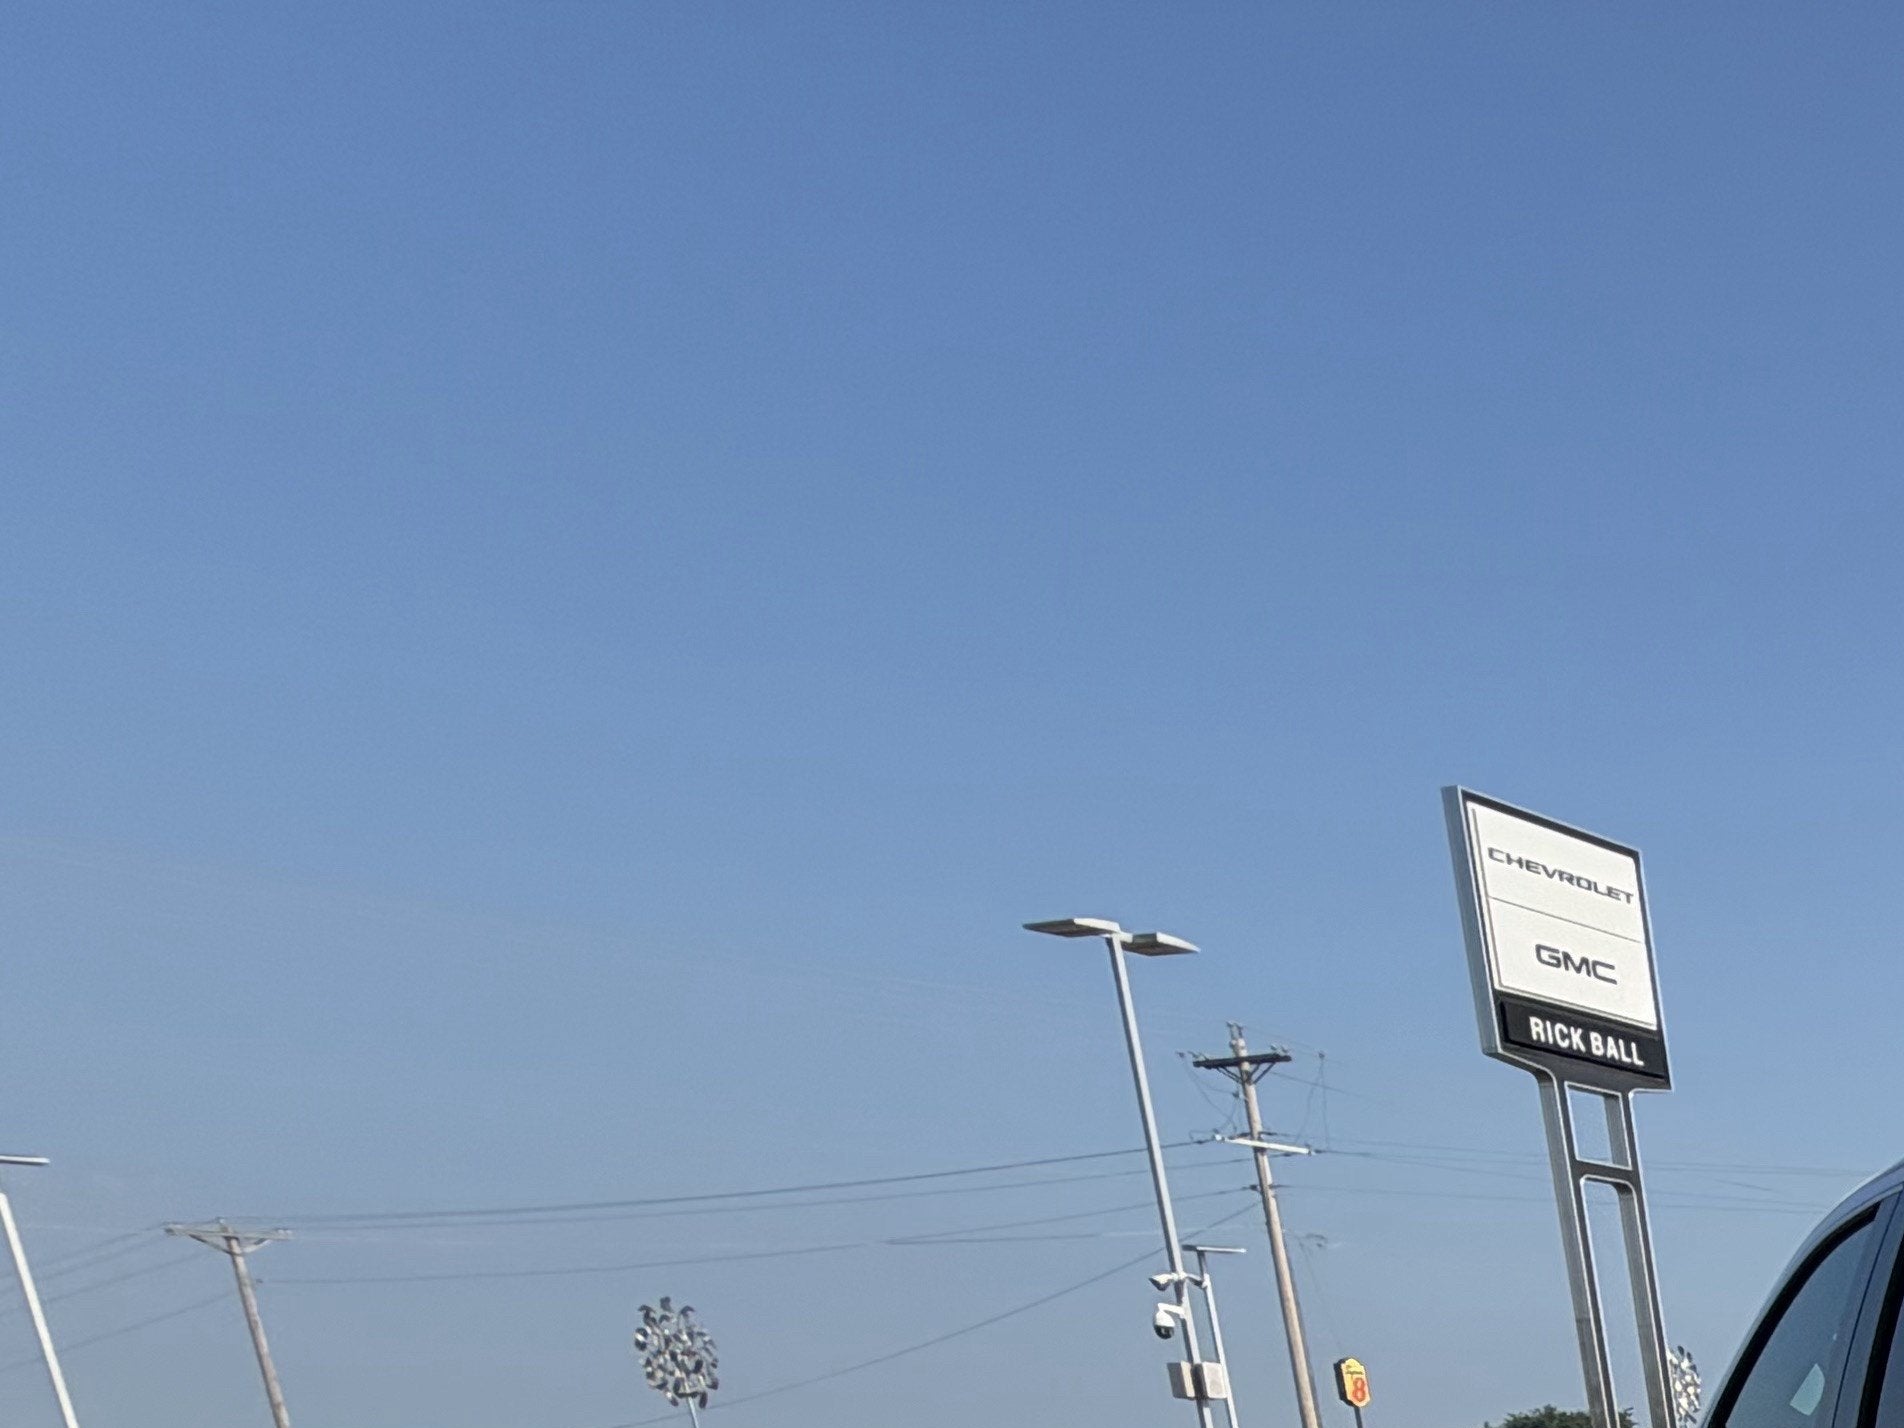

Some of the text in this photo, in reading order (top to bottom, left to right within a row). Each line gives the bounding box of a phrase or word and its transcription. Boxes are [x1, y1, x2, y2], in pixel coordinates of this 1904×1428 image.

[1487, 846, 1634, 904] CHEVROLET
[1535, 943, 1617, 985] GMC
[1528, 1015, 1644, 1066] RICK BALL
